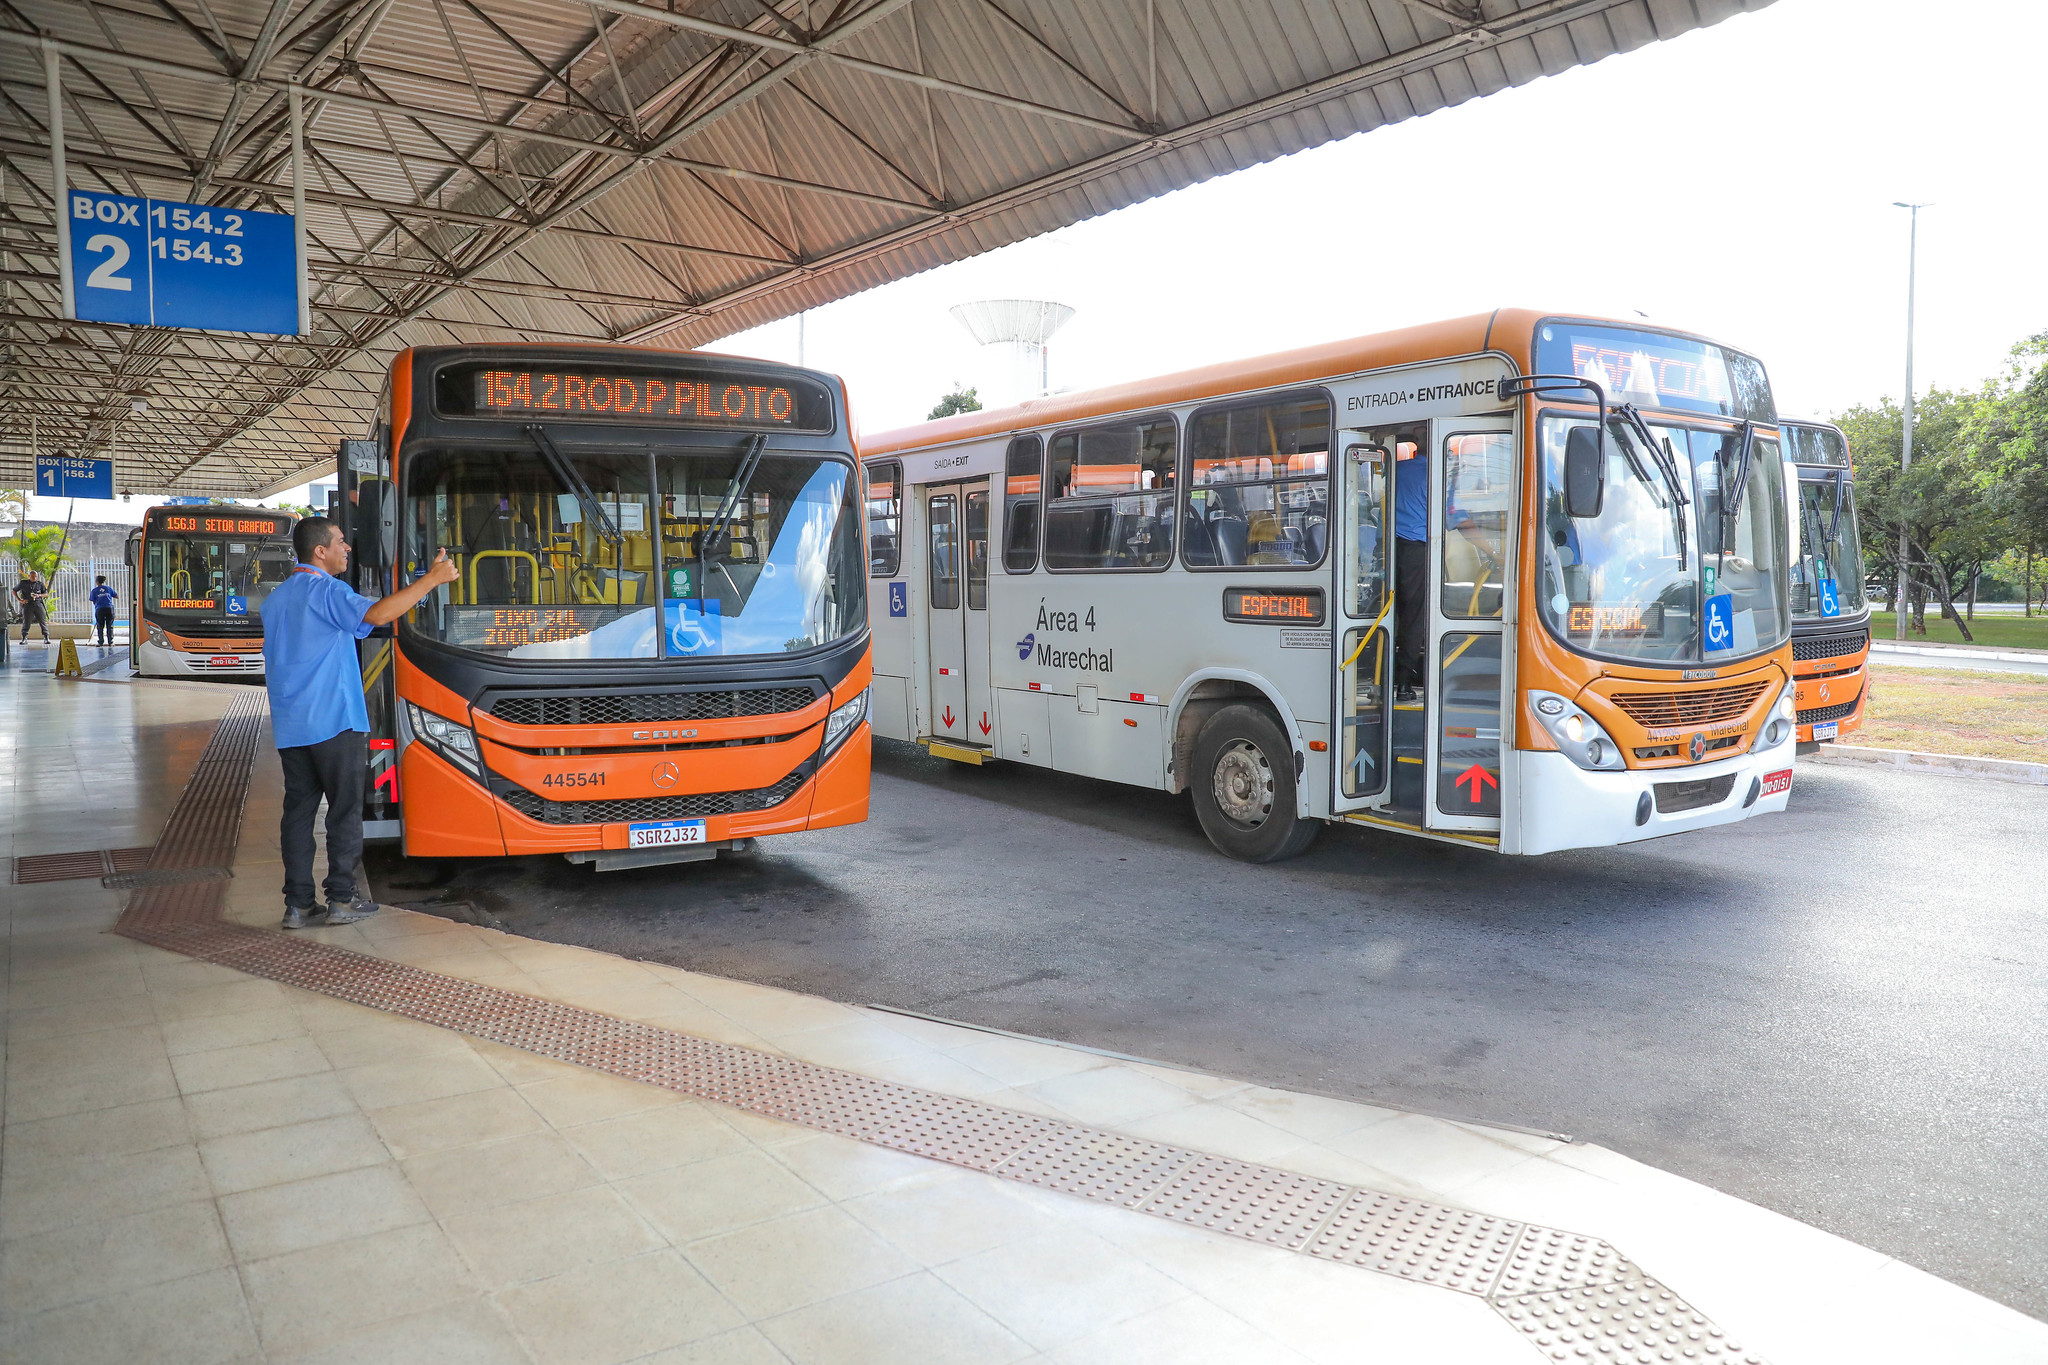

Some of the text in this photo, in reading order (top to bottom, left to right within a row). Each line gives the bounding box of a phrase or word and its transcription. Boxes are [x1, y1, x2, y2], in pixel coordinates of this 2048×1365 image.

[73, 196, 140, 227] BOX
[151, 206, 244, 237] 154.2
[151, 237, 244, 266] 154.3
[86, 234, 132, 291] 2
[1348, 379, 1495, 411] ENTRADA ENTRANCE
[38, 458, 60, 467] BOX
[63, 460, 95, 469] 156.7
[956, 455, 969, 466] EXIT
[43, 469, 55, 487] 1
[64, 469, 95, 479] 156.8
[205, 519, 235, 532] SETOR
[238, 520, 275, 534] GRAFICO
[160, 599, 215, 609] INTEGRACAO
[1240, 594, 1313, 618] ESPECIAL
[494, 609, 580, 626] EIXO SUL
[1036, 597, 1096, 632] Área 4
[1570, 607, 1647, 630] ESPECIAL
[1037, 643, 1114, 672] Marechal
[1681, 669, 1718, 680] Marcopolo
[633, 729, 698, 740] CAIO
[1709, 717, 1749, 737] Marechal
[542, 772, 605, 787] 445541
[637, 827, 698, 845] SGR2J32
